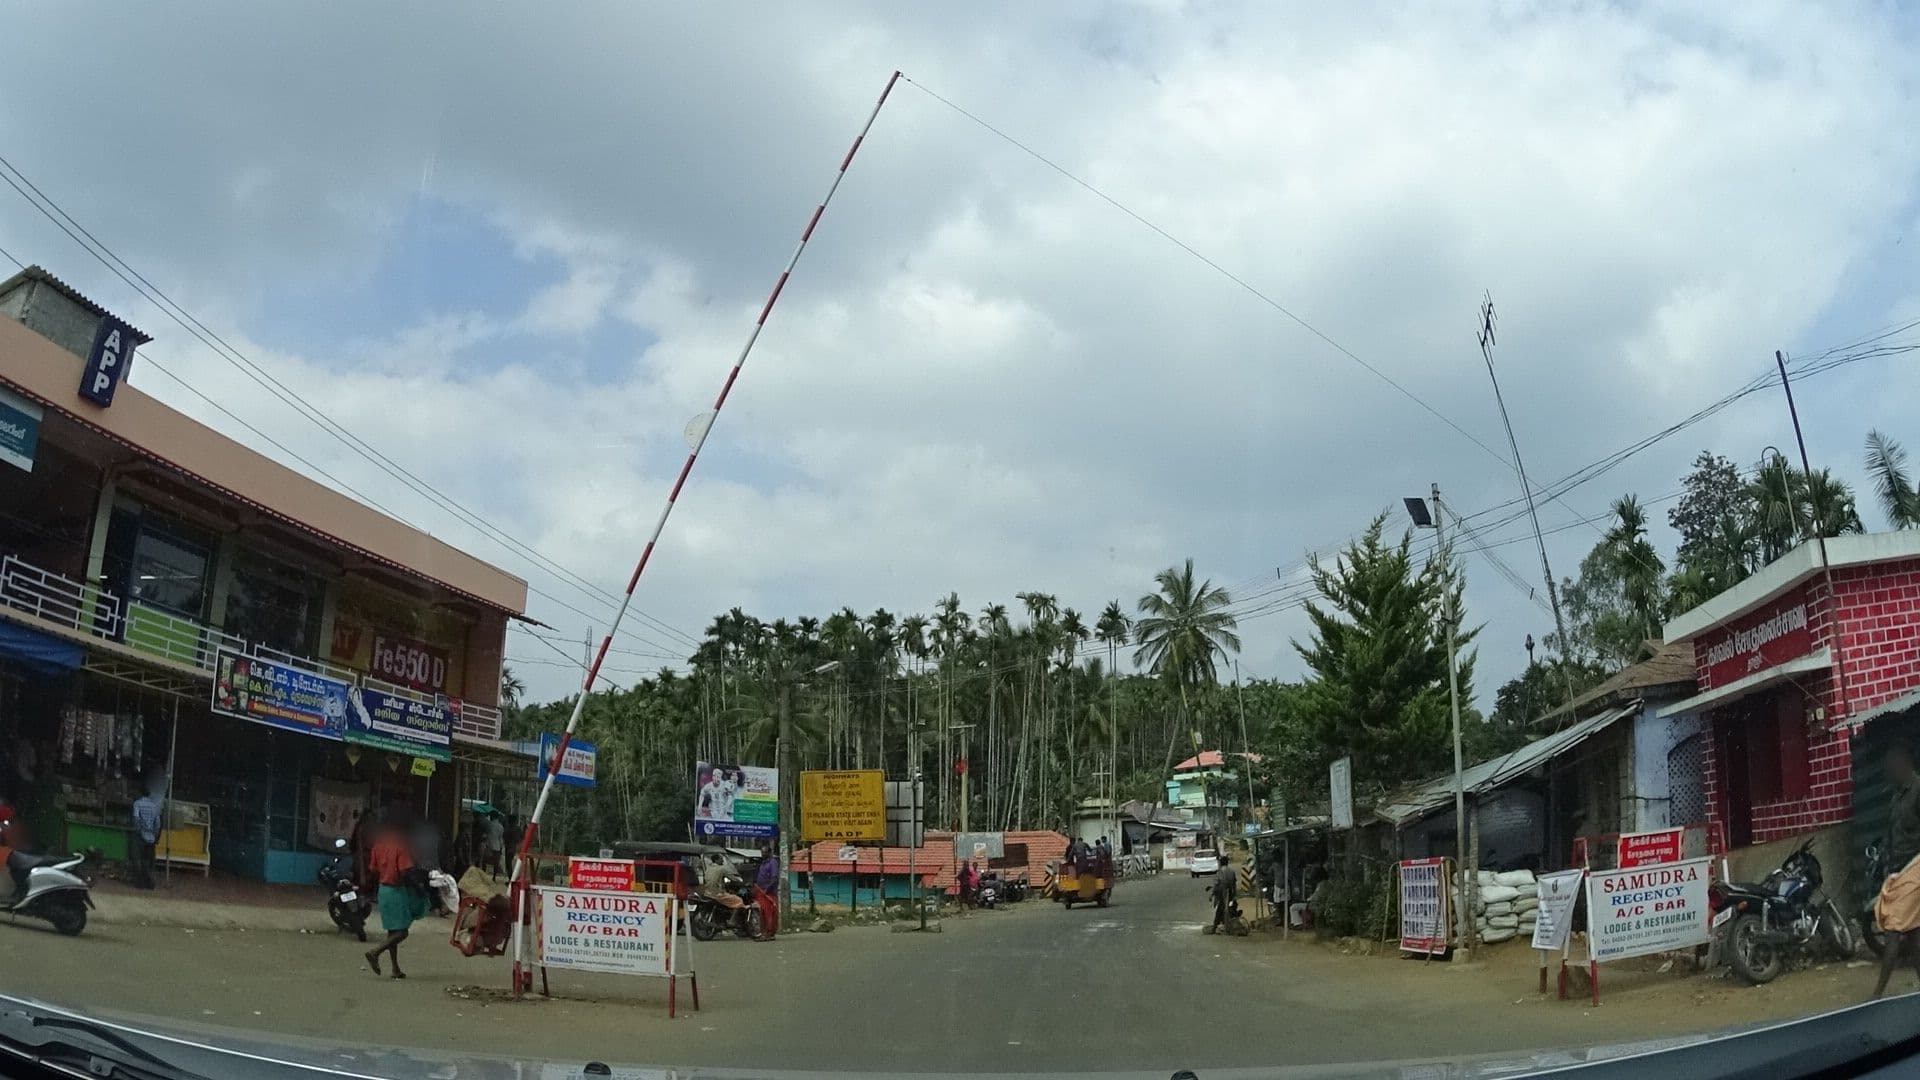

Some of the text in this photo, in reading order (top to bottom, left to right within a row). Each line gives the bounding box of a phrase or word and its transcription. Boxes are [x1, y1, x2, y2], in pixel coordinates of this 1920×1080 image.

[92, 329, 120, 394] APP
[1603, 867, 1698, 893] SAMUDRA
[555, 894, 657, 914] SAMUDRA
[1611, 886, 1684, 906] REGENCY
[567, 911, 646, 926] REGENCY
[1616, 899, 1686, 918] A/C BAR
[568, 924, 639, 937] A/C BAR
[1604, 911, 1697, 935] LODGE & RESTAURANT
[549, 935, 654, 952] LODGE & RESTAURANT
